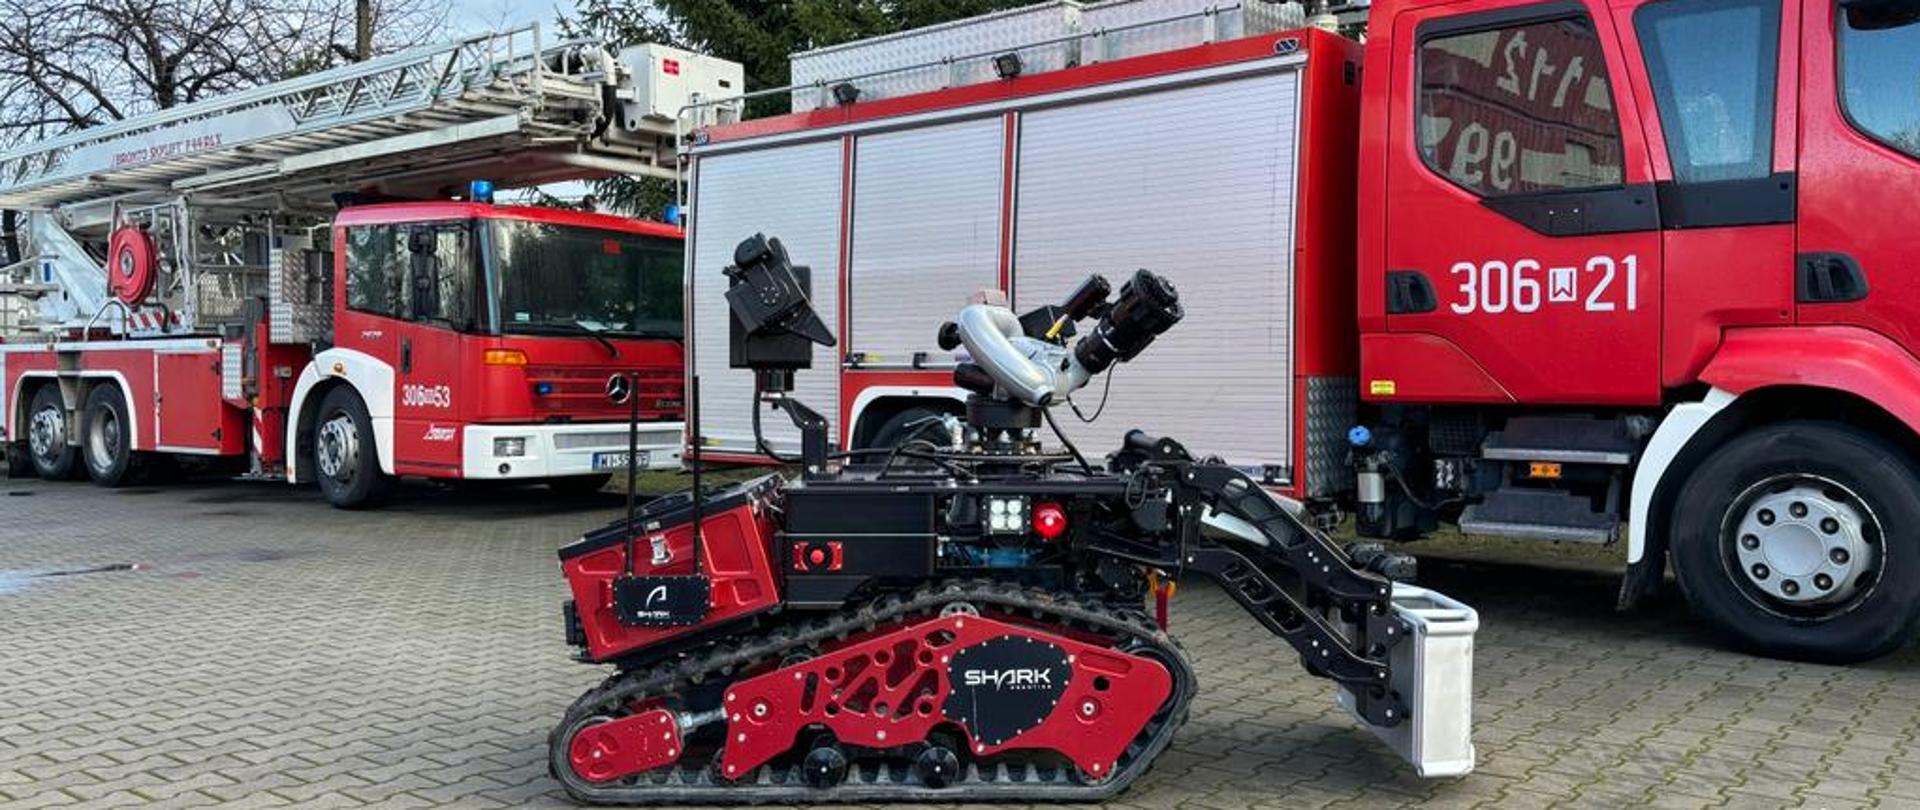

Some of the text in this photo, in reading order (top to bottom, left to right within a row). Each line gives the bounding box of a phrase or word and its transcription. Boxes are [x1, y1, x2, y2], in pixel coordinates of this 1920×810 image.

[1450, 259, 1541, 314] 306
[1585, 254, 1637, 311] 21
[402, 385, 425, 406] 306
[434, 385, 451, 408] 53
[964, 668, 1052, 691] SHARK
